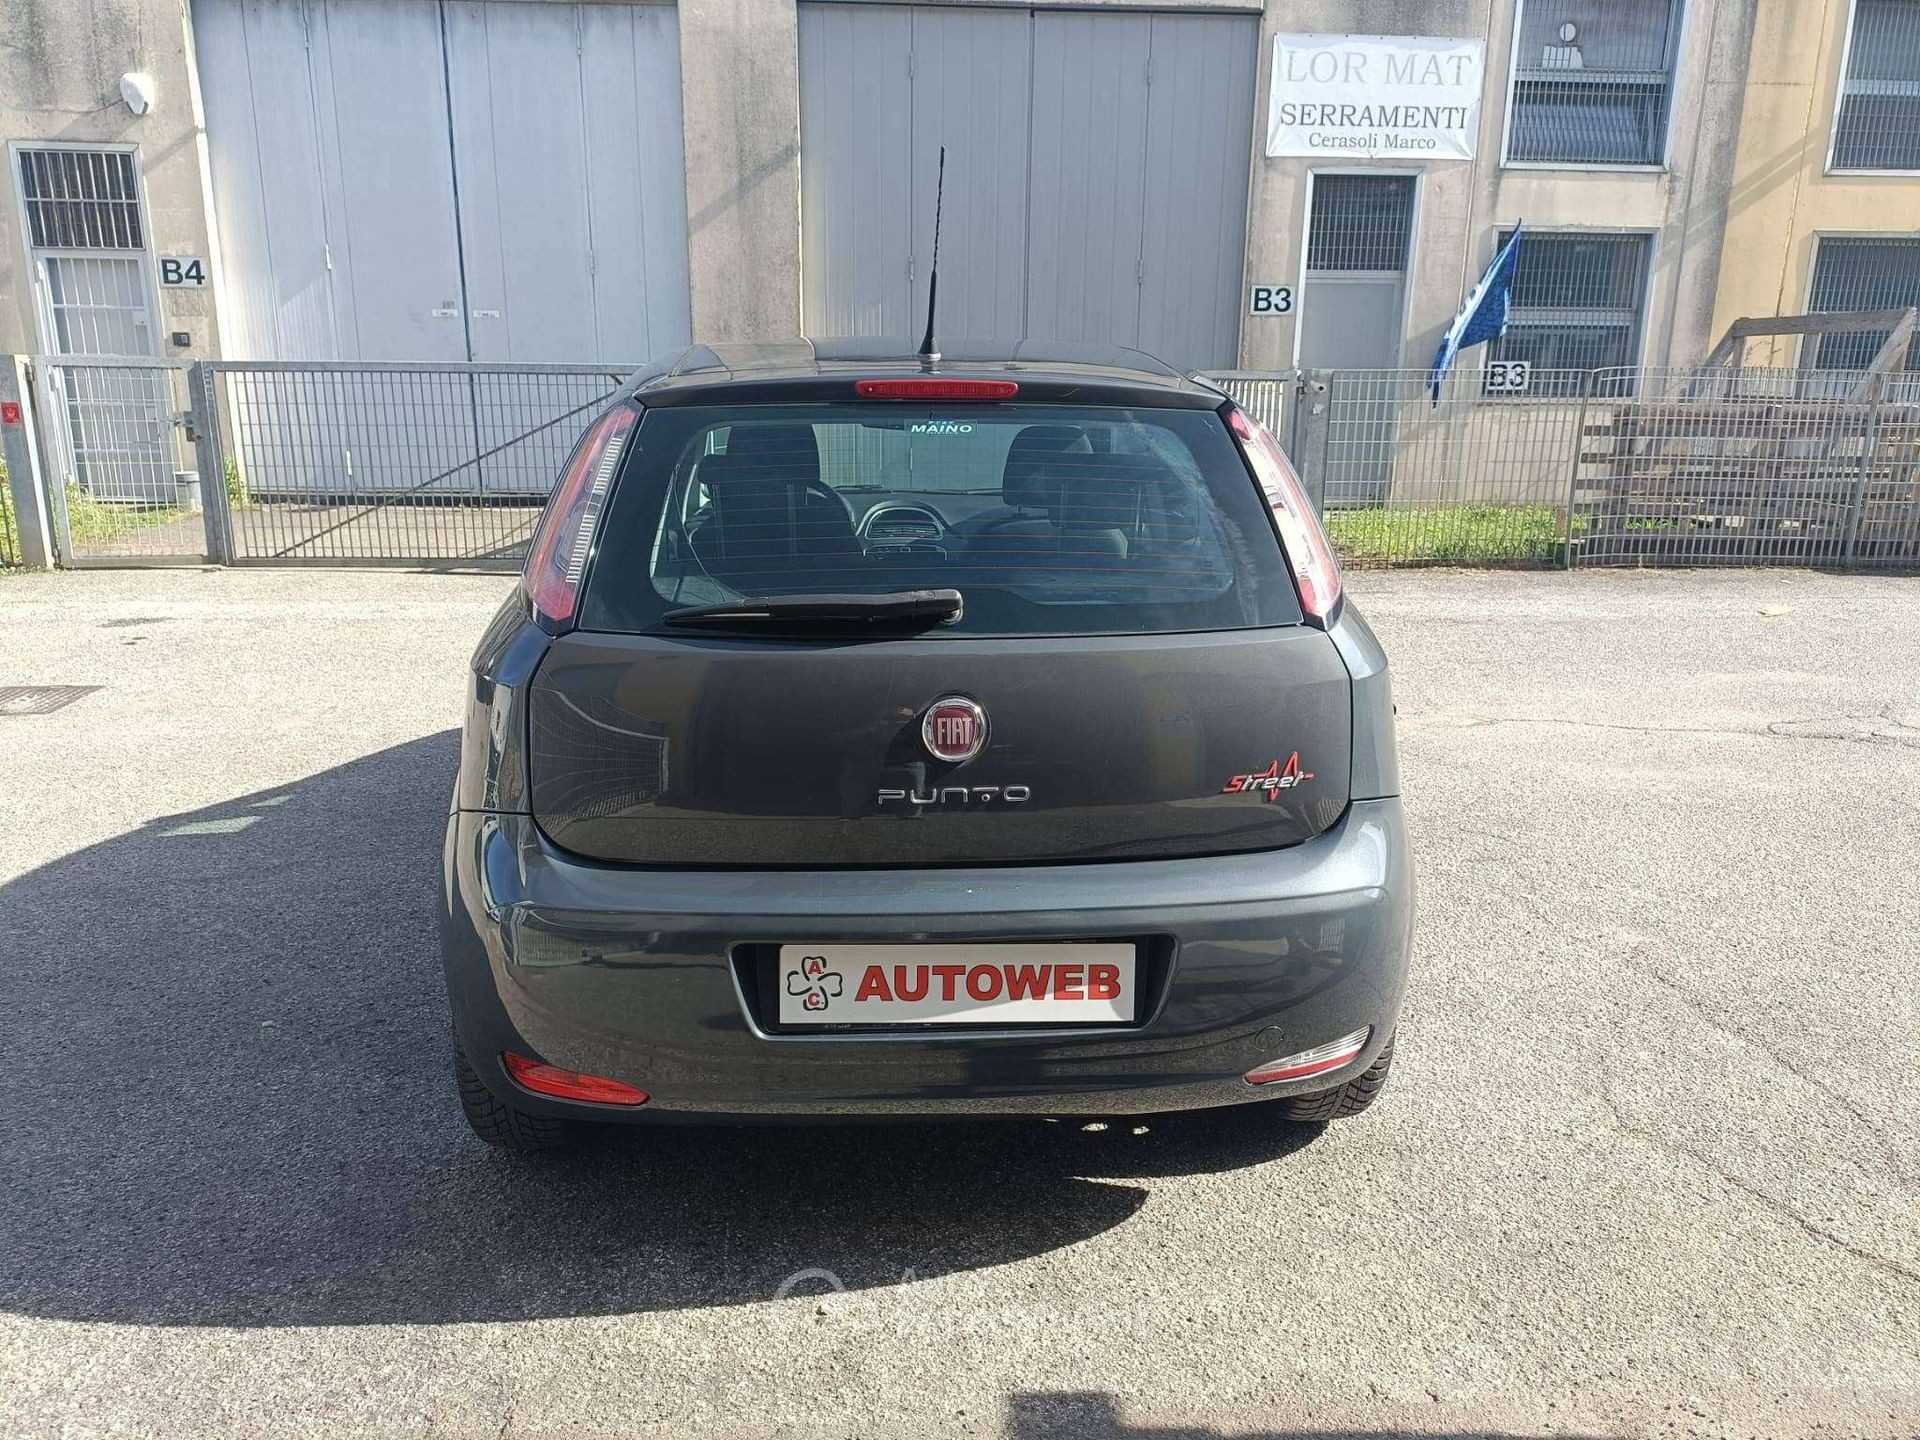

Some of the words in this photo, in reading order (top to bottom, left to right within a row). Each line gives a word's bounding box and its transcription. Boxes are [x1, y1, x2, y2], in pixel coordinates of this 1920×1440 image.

[1286, 50, 1368, 84] LOR
[1384, 52, 1472, 86] MAT
[1280, 103, 1467, 129] SERRAMENTI
[1308, 132, 1377, 149] Cerasoli
[1384, 134, 1436, 150] Marco
[161, 259, 205, 285] B4
[1253, 287, 1291, 312] B3
[1489, 363, 1526, 387] B3
[911, 425, 972, 433] MAINO
[937, 717, 972, 745] FIAT
[878, 786, 1030, 804] PUNTO
[854, 964, 1122, 1002] AUTOWEB
